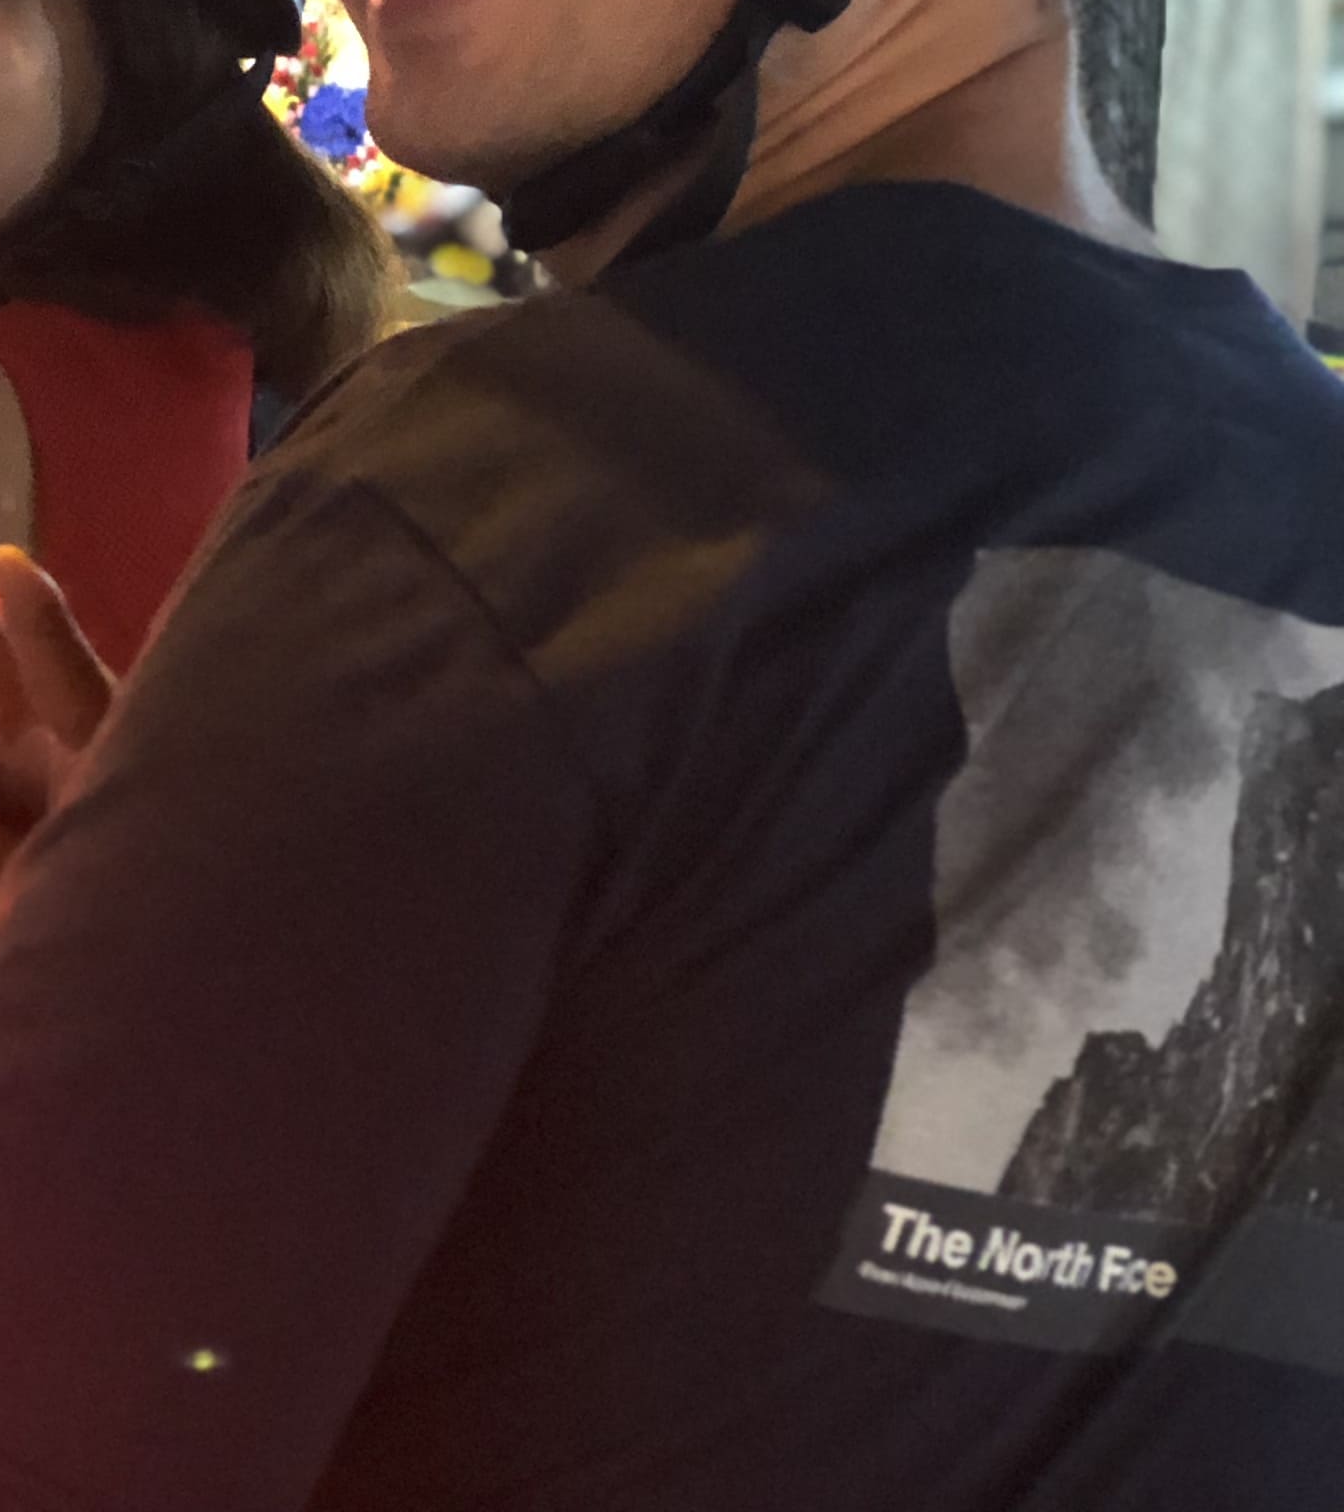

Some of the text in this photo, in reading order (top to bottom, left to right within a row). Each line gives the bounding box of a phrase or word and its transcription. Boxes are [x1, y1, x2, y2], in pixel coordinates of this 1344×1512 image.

[882, 1203, 974, 1268] The
[977, 1227, 1096, 1287] North
[1098, 1245, 1178, 1298] Fce
